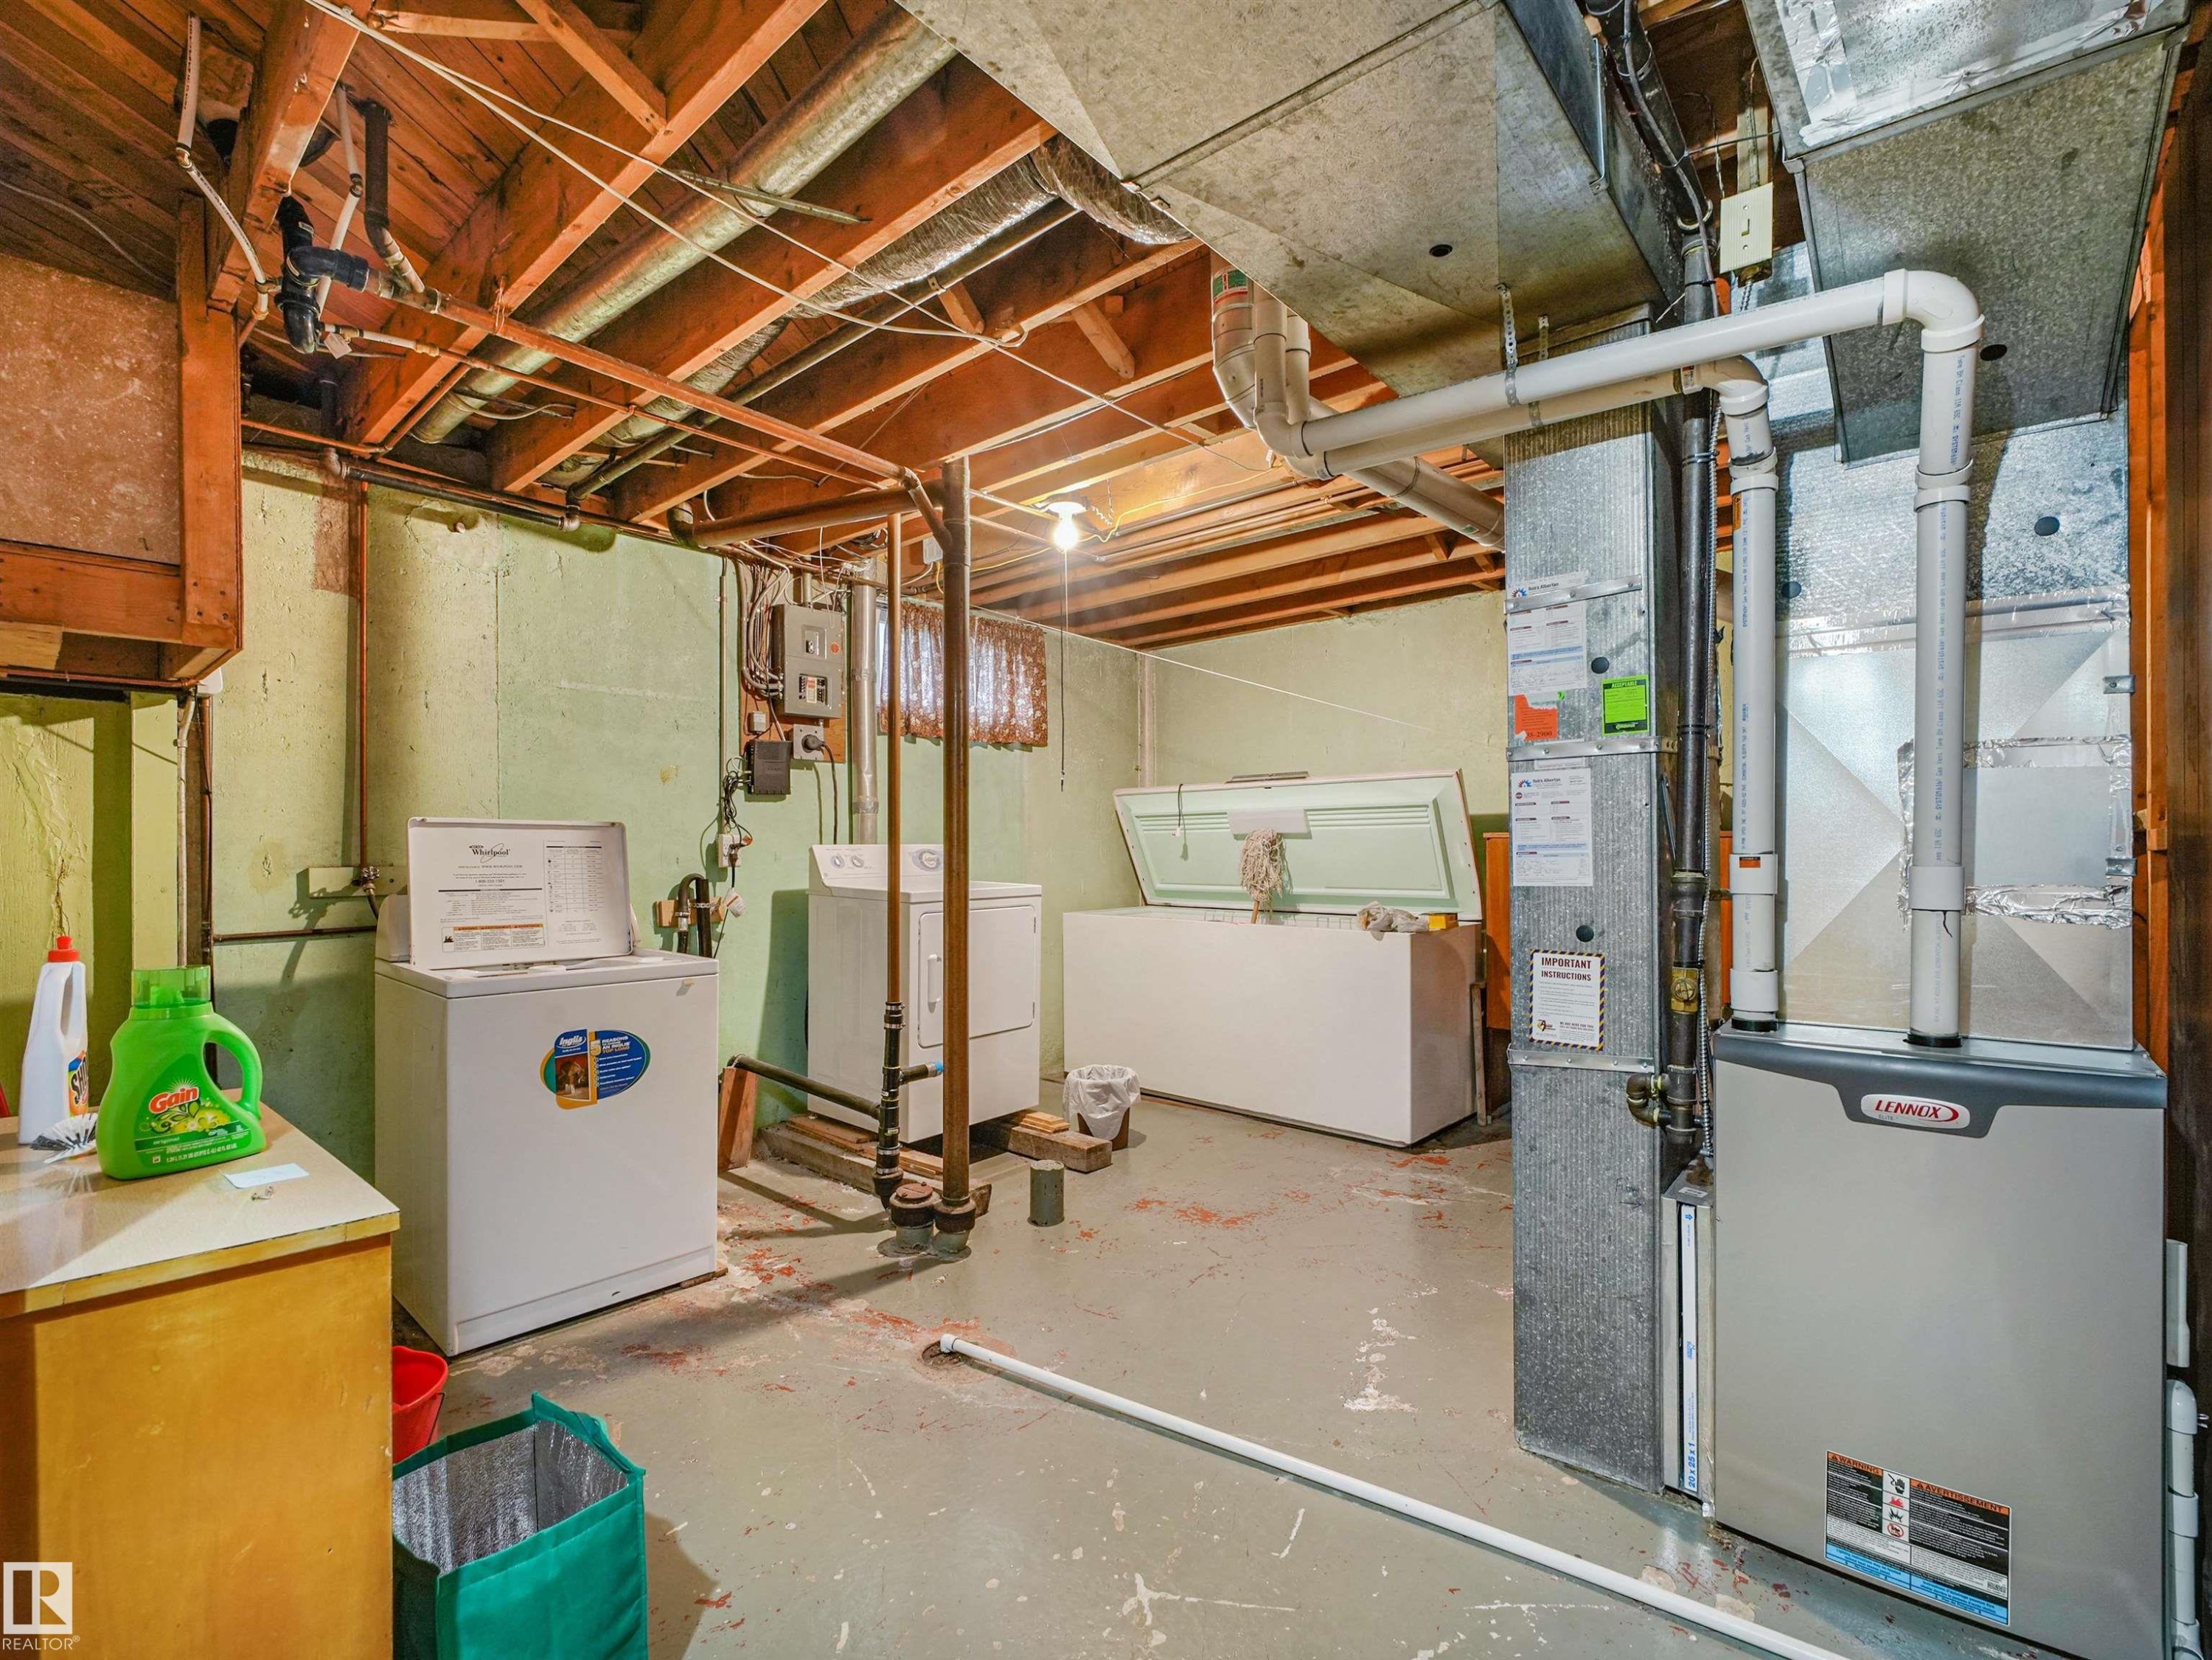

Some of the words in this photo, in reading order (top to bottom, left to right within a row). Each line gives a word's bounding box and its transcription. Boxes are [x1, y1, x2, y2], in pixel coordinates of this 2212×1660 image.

[472, 849, 509, 857] Whirlpool
[1541, 957, 1592, 969] IMPORTANT
[1541, 970, 1591, 982] INSTRUCTIONS
[559, 1035, 583, 1046] Inglis
[602, 1035, 629, 1043] REASONS
[590, 1039, 602, 1057] 5
[150, 1087, 199, 1114] Gain
[1875, 1100, 1941, 1119] LENNOX
[1688, 1456, 1695, 1468] 25
[1839, 1456, 1879, 1474] WARNING
[1688, 1476, 1695, 1488] 20
[1925, 1484, 2003, 1513] AVERTISSEMENT
